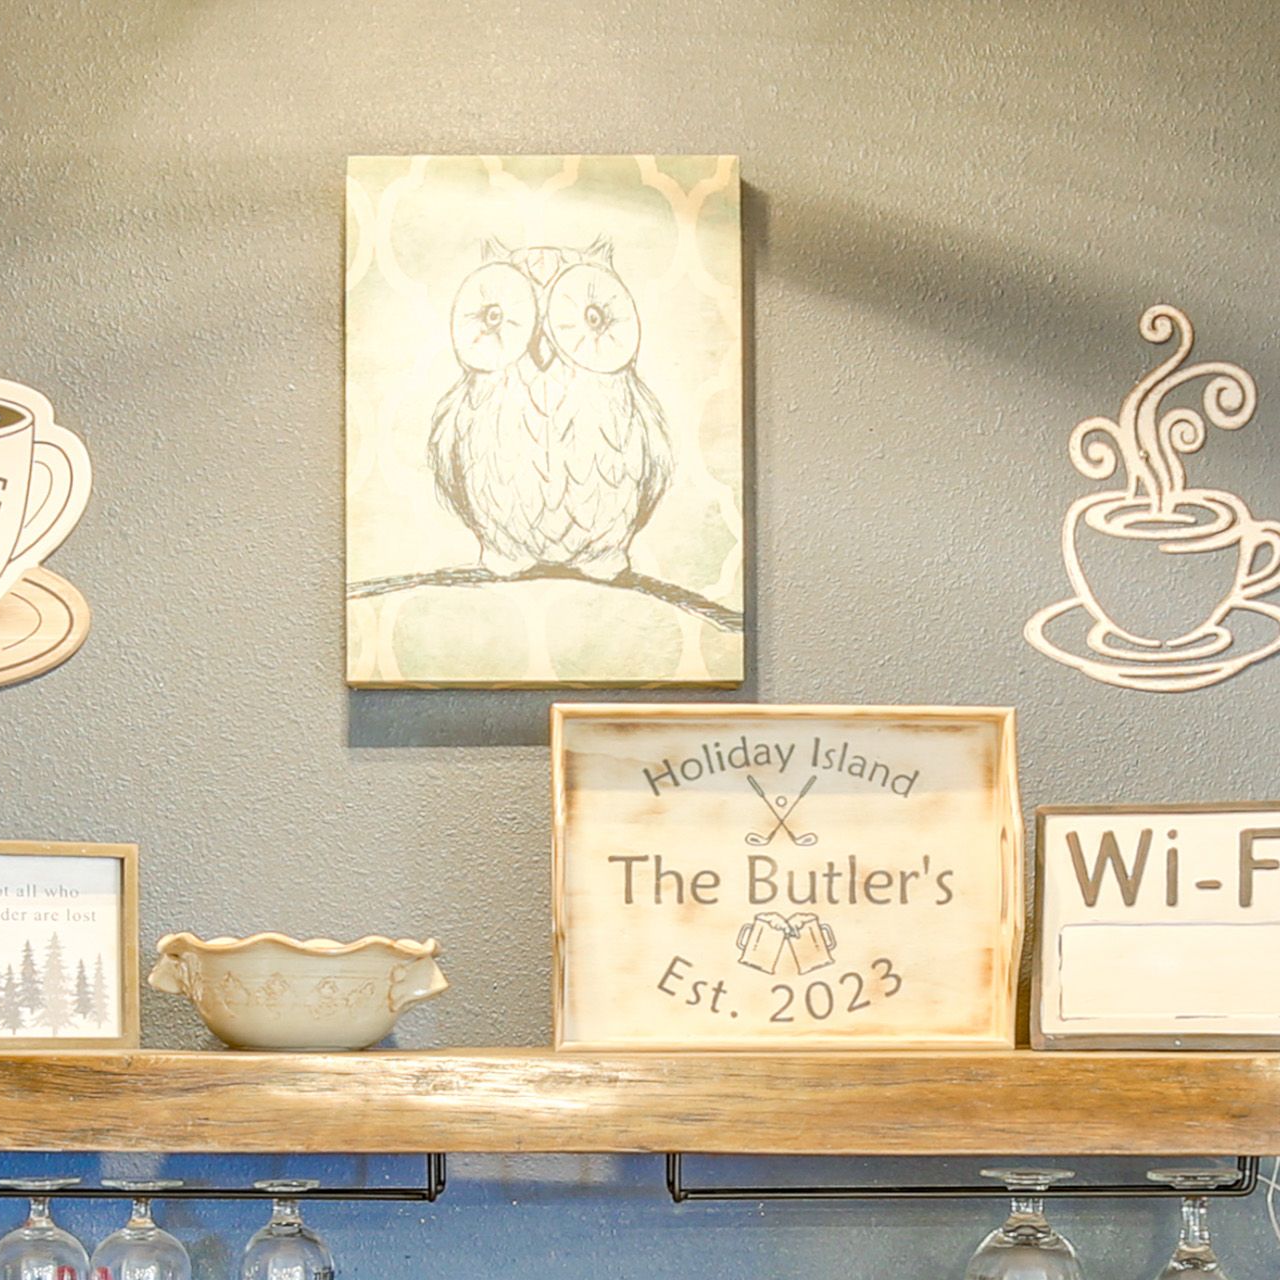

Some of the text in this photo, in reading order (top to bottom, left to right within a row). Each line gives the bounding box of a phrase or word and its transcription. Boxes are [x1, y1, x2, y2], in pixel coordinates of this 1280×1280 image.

[642, 736, 921, 799] Holiday Island
[16, 884, 37, 898] all
[44, 884, 80, 899] who
[608, 853, 954, 906] The Butler's
[34, 910, 59, 922] are
[67, 908, 97, 922] lost
[657, 954, 903, 1023] Est. 2023
